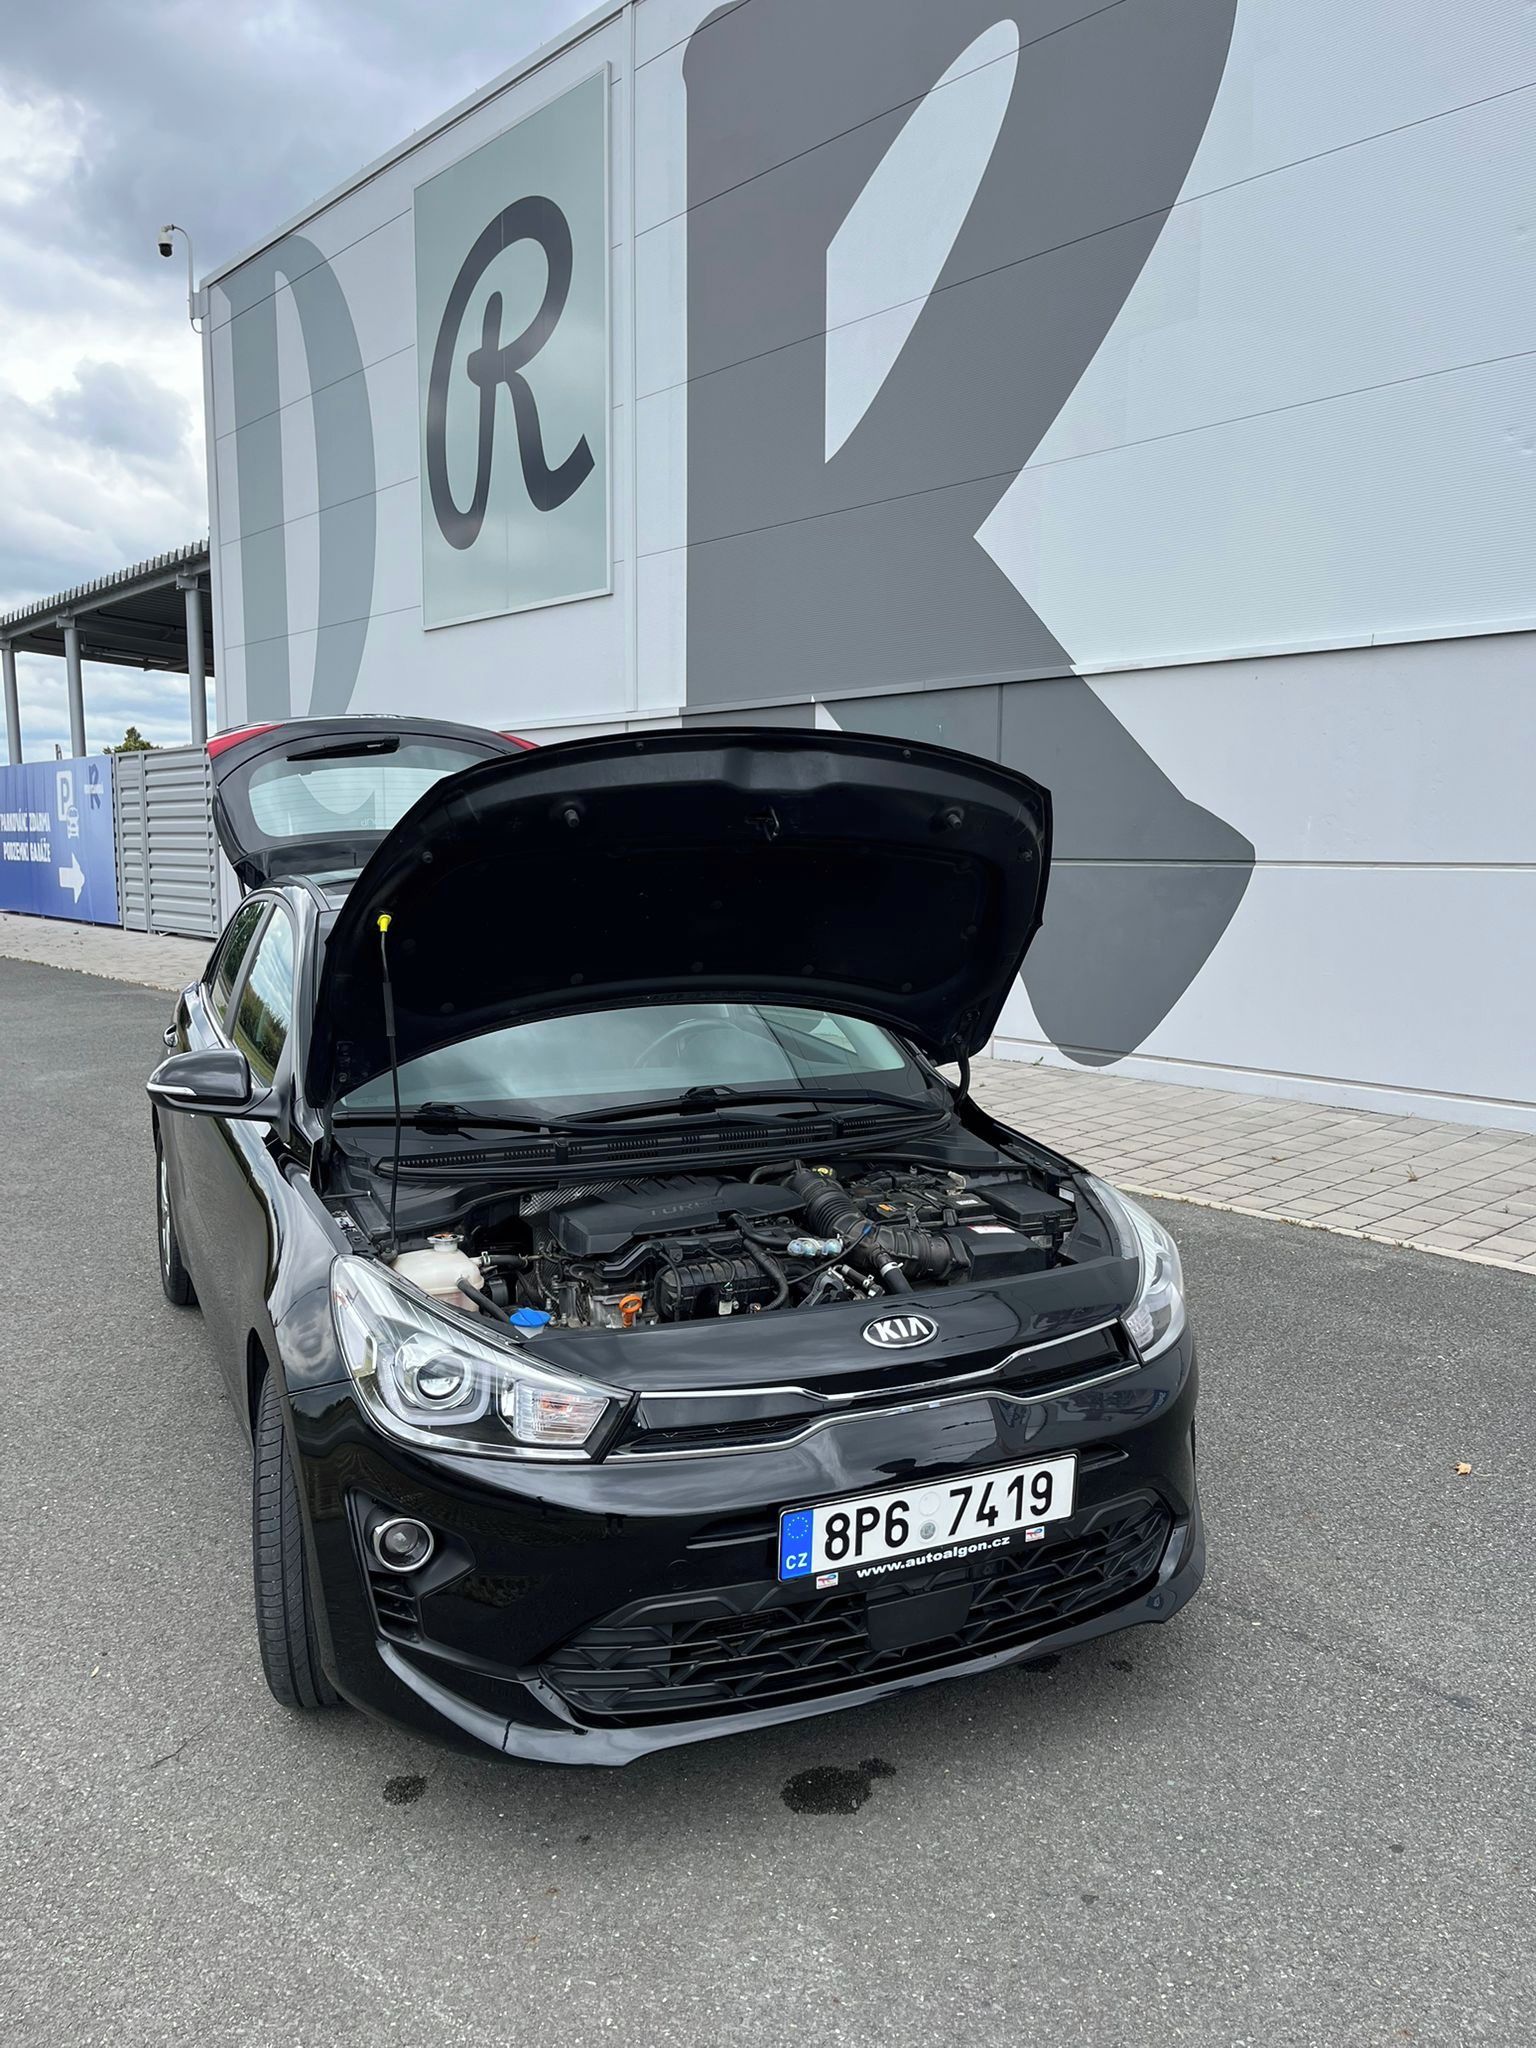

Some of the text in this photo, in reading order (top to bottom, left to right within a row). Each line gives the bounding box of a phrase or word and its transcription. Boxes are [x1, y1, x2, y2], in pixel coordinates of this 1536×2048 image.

[873, 1317, 930, 1342] KIA
[824, 1470, 1054, 1562] 8P6 7419
[785, 1552, 808, 1570] CZ
[856, 1536, 1011, 1578] www.autoalgon.cz
